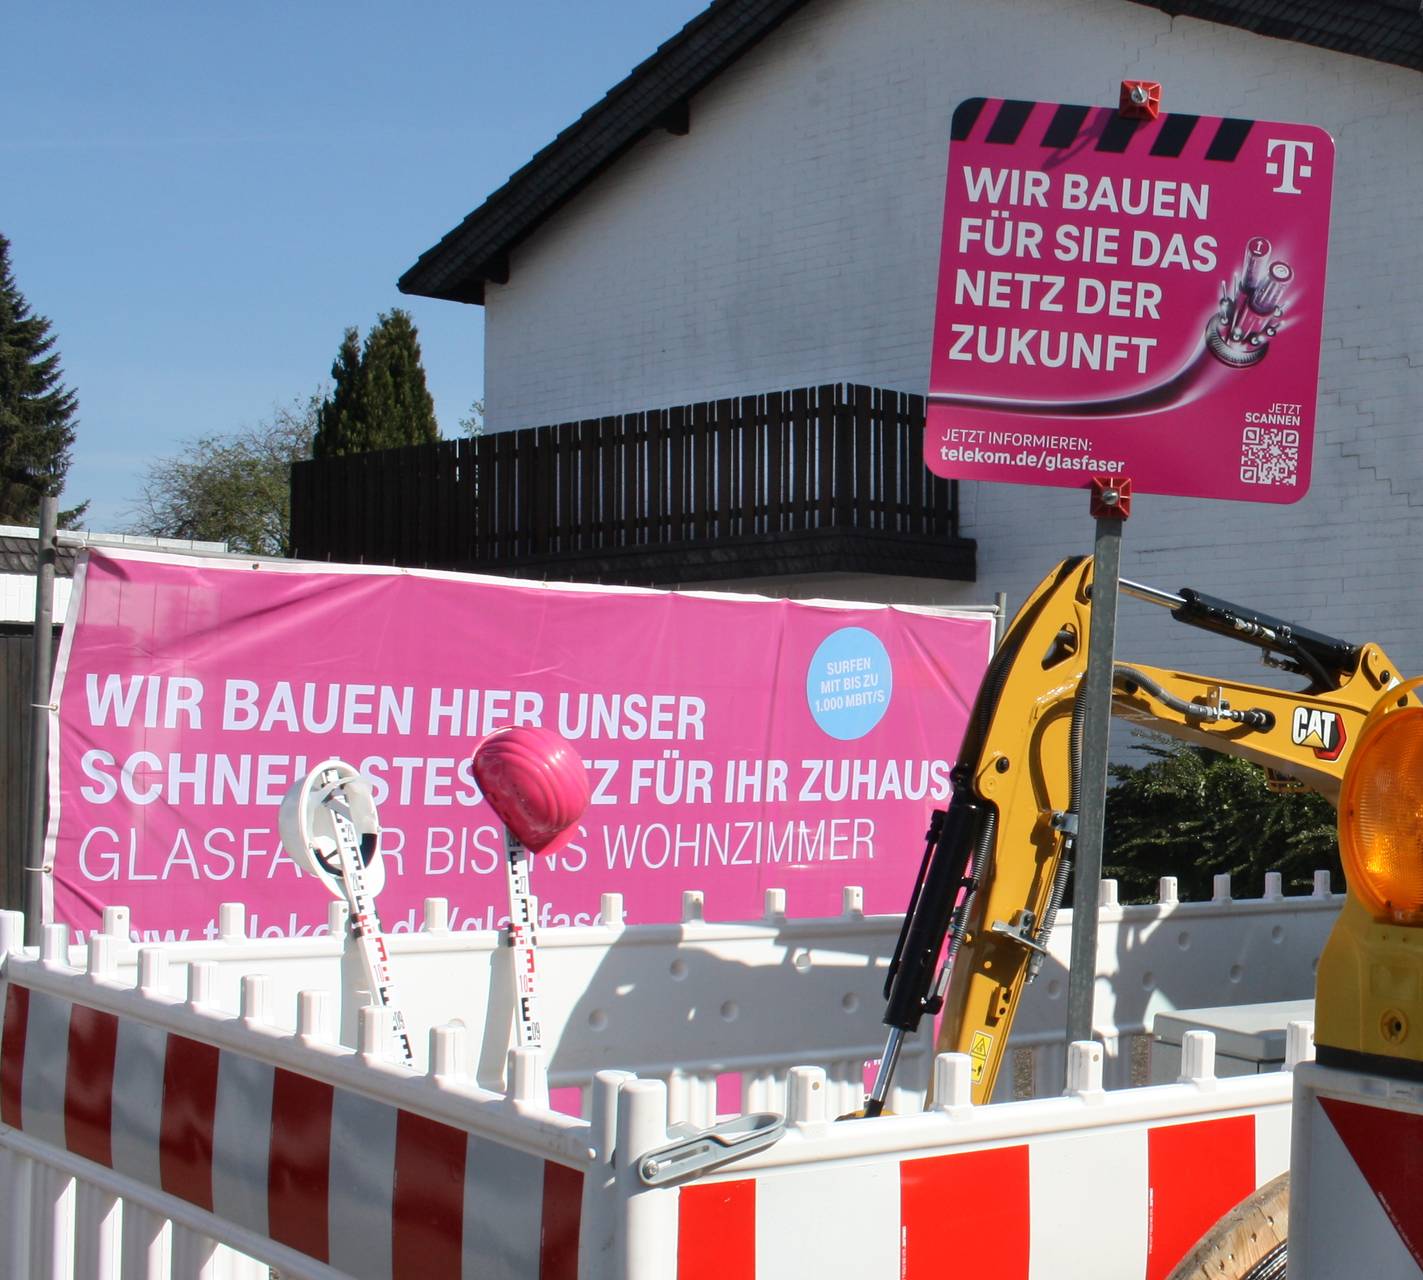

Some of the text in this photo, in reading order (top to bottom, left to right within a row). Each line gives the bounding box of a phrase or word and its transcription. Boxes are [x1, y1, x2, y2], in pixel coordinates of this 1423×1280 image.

[1265, 138, 1314, 195] T
[963, 166, 1210, 220] WIR BAUEN
[958, 210, 1218, 272] FÜR SIE DAS
[954, 268, 1162, 320] NETZ DER
[948, 323, 1158, 374] ZUKUNFT
[1245, 411, 1301, 426] SCANNEN
[1268, 403, 1301, 415] JETZT
[940, 445, 1125, 474] telekom.de/glasfaser
[941, 428, 1093, 452] JETZT INFORMIEREN:
[821, 673, 878, 694] MIT BIS ZU
[826, 657, 871, 676] SURFEN
[86, 673, 706, 741] WIR BAUEN HIER UNSER
[816, 689, 885, 713] 1.000 MBIT/S
[1292, 706, 1336, 749] CAT
[80, 749, 486, 806] SCHNESTES
[629, 749, 714, 805] FÜR
[724, 759, 789, 803] IHR
[798, 759, 957, 802] ZUHAUS
[78, 826, 405, 882] GLASFAR
[425, 825, 500, 876] BIS
[603, 817, 876, 871] WOHNZIMMER
[519, 973, 529, 993] 10
